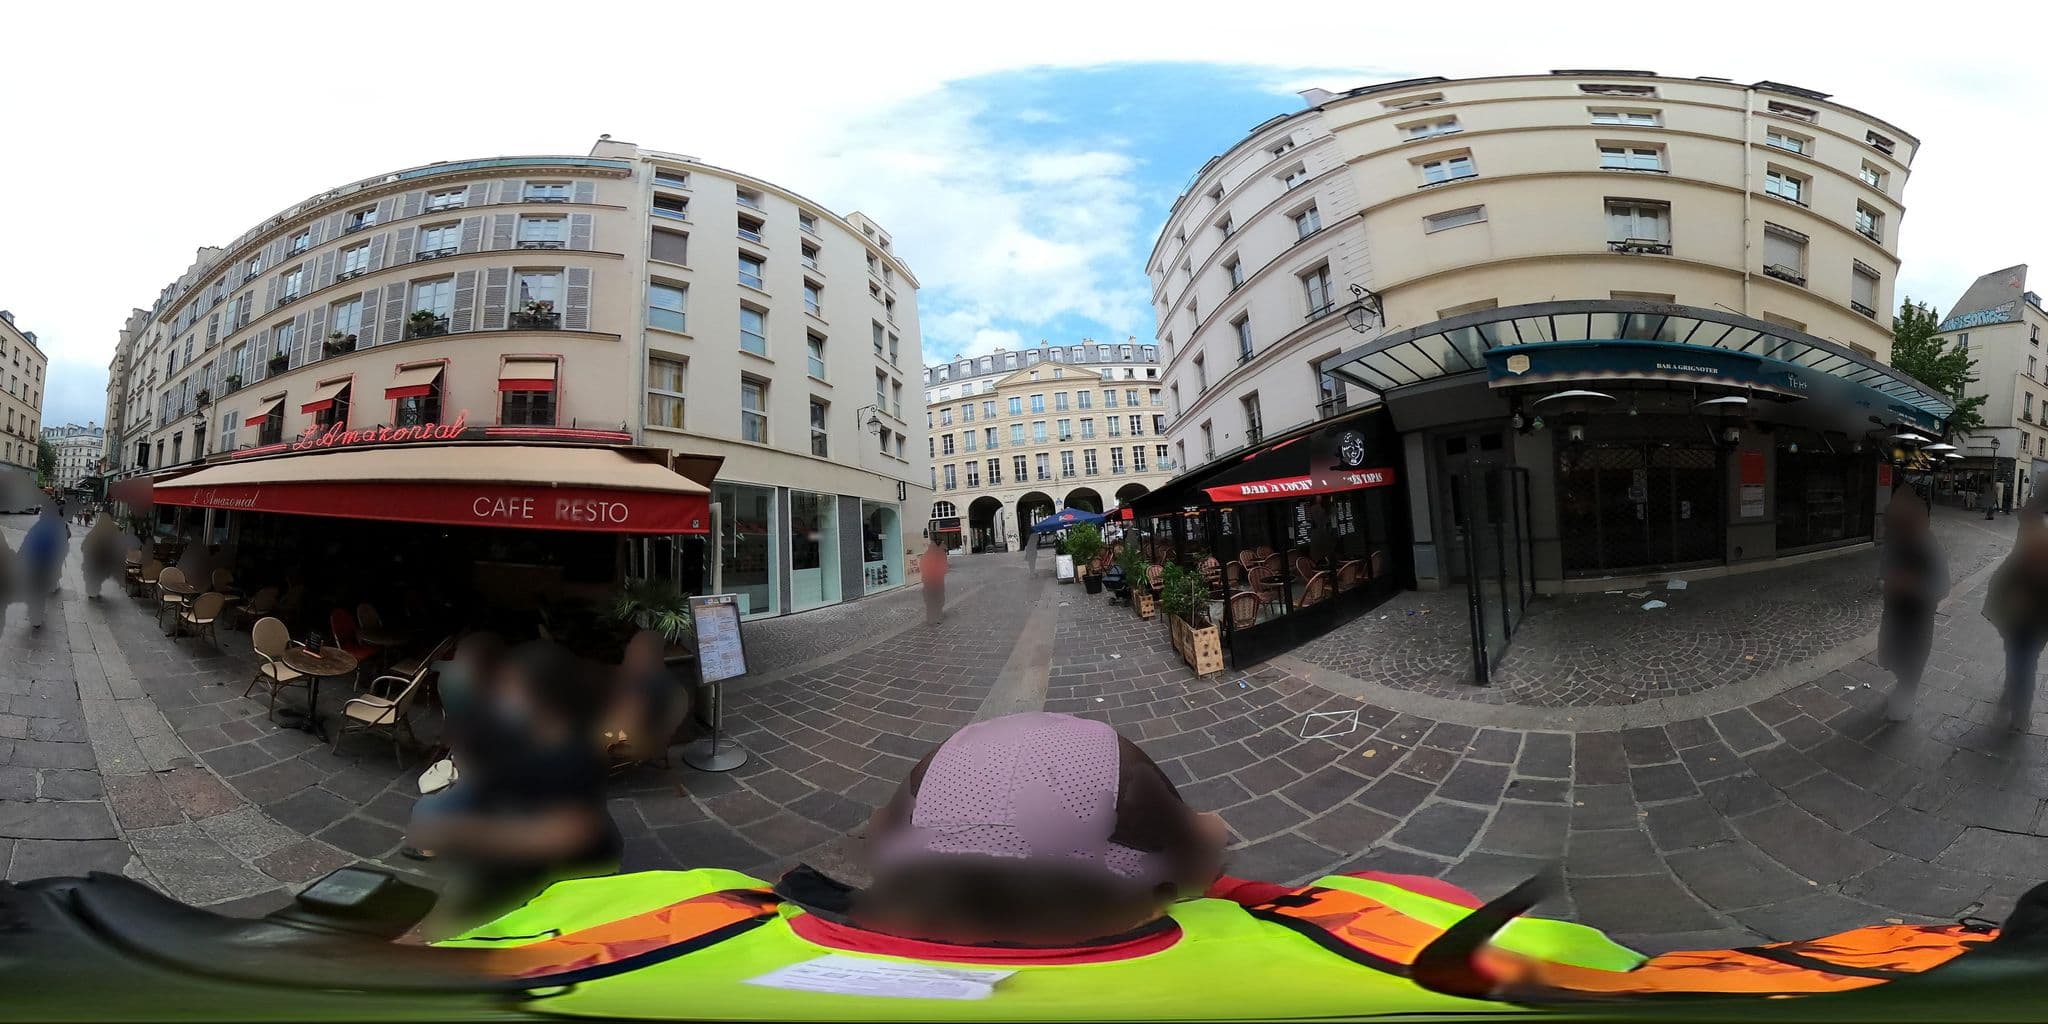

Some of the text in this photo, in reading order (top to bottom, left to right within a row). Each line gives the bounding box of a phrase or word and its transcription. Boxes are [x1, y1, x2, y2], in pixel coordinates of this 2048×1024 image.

[1678, 364, 1718, 374] GRIGNOTER
[293, 409, 468, 450] L'Amazonial
[1241, 485, 1268, 495] BAR
[1361, 472, 1383, 484] TAPAS
[191, 488, 260, 508] L'Amazonial
[473, 497, 629, 523] CAFE RESTO
